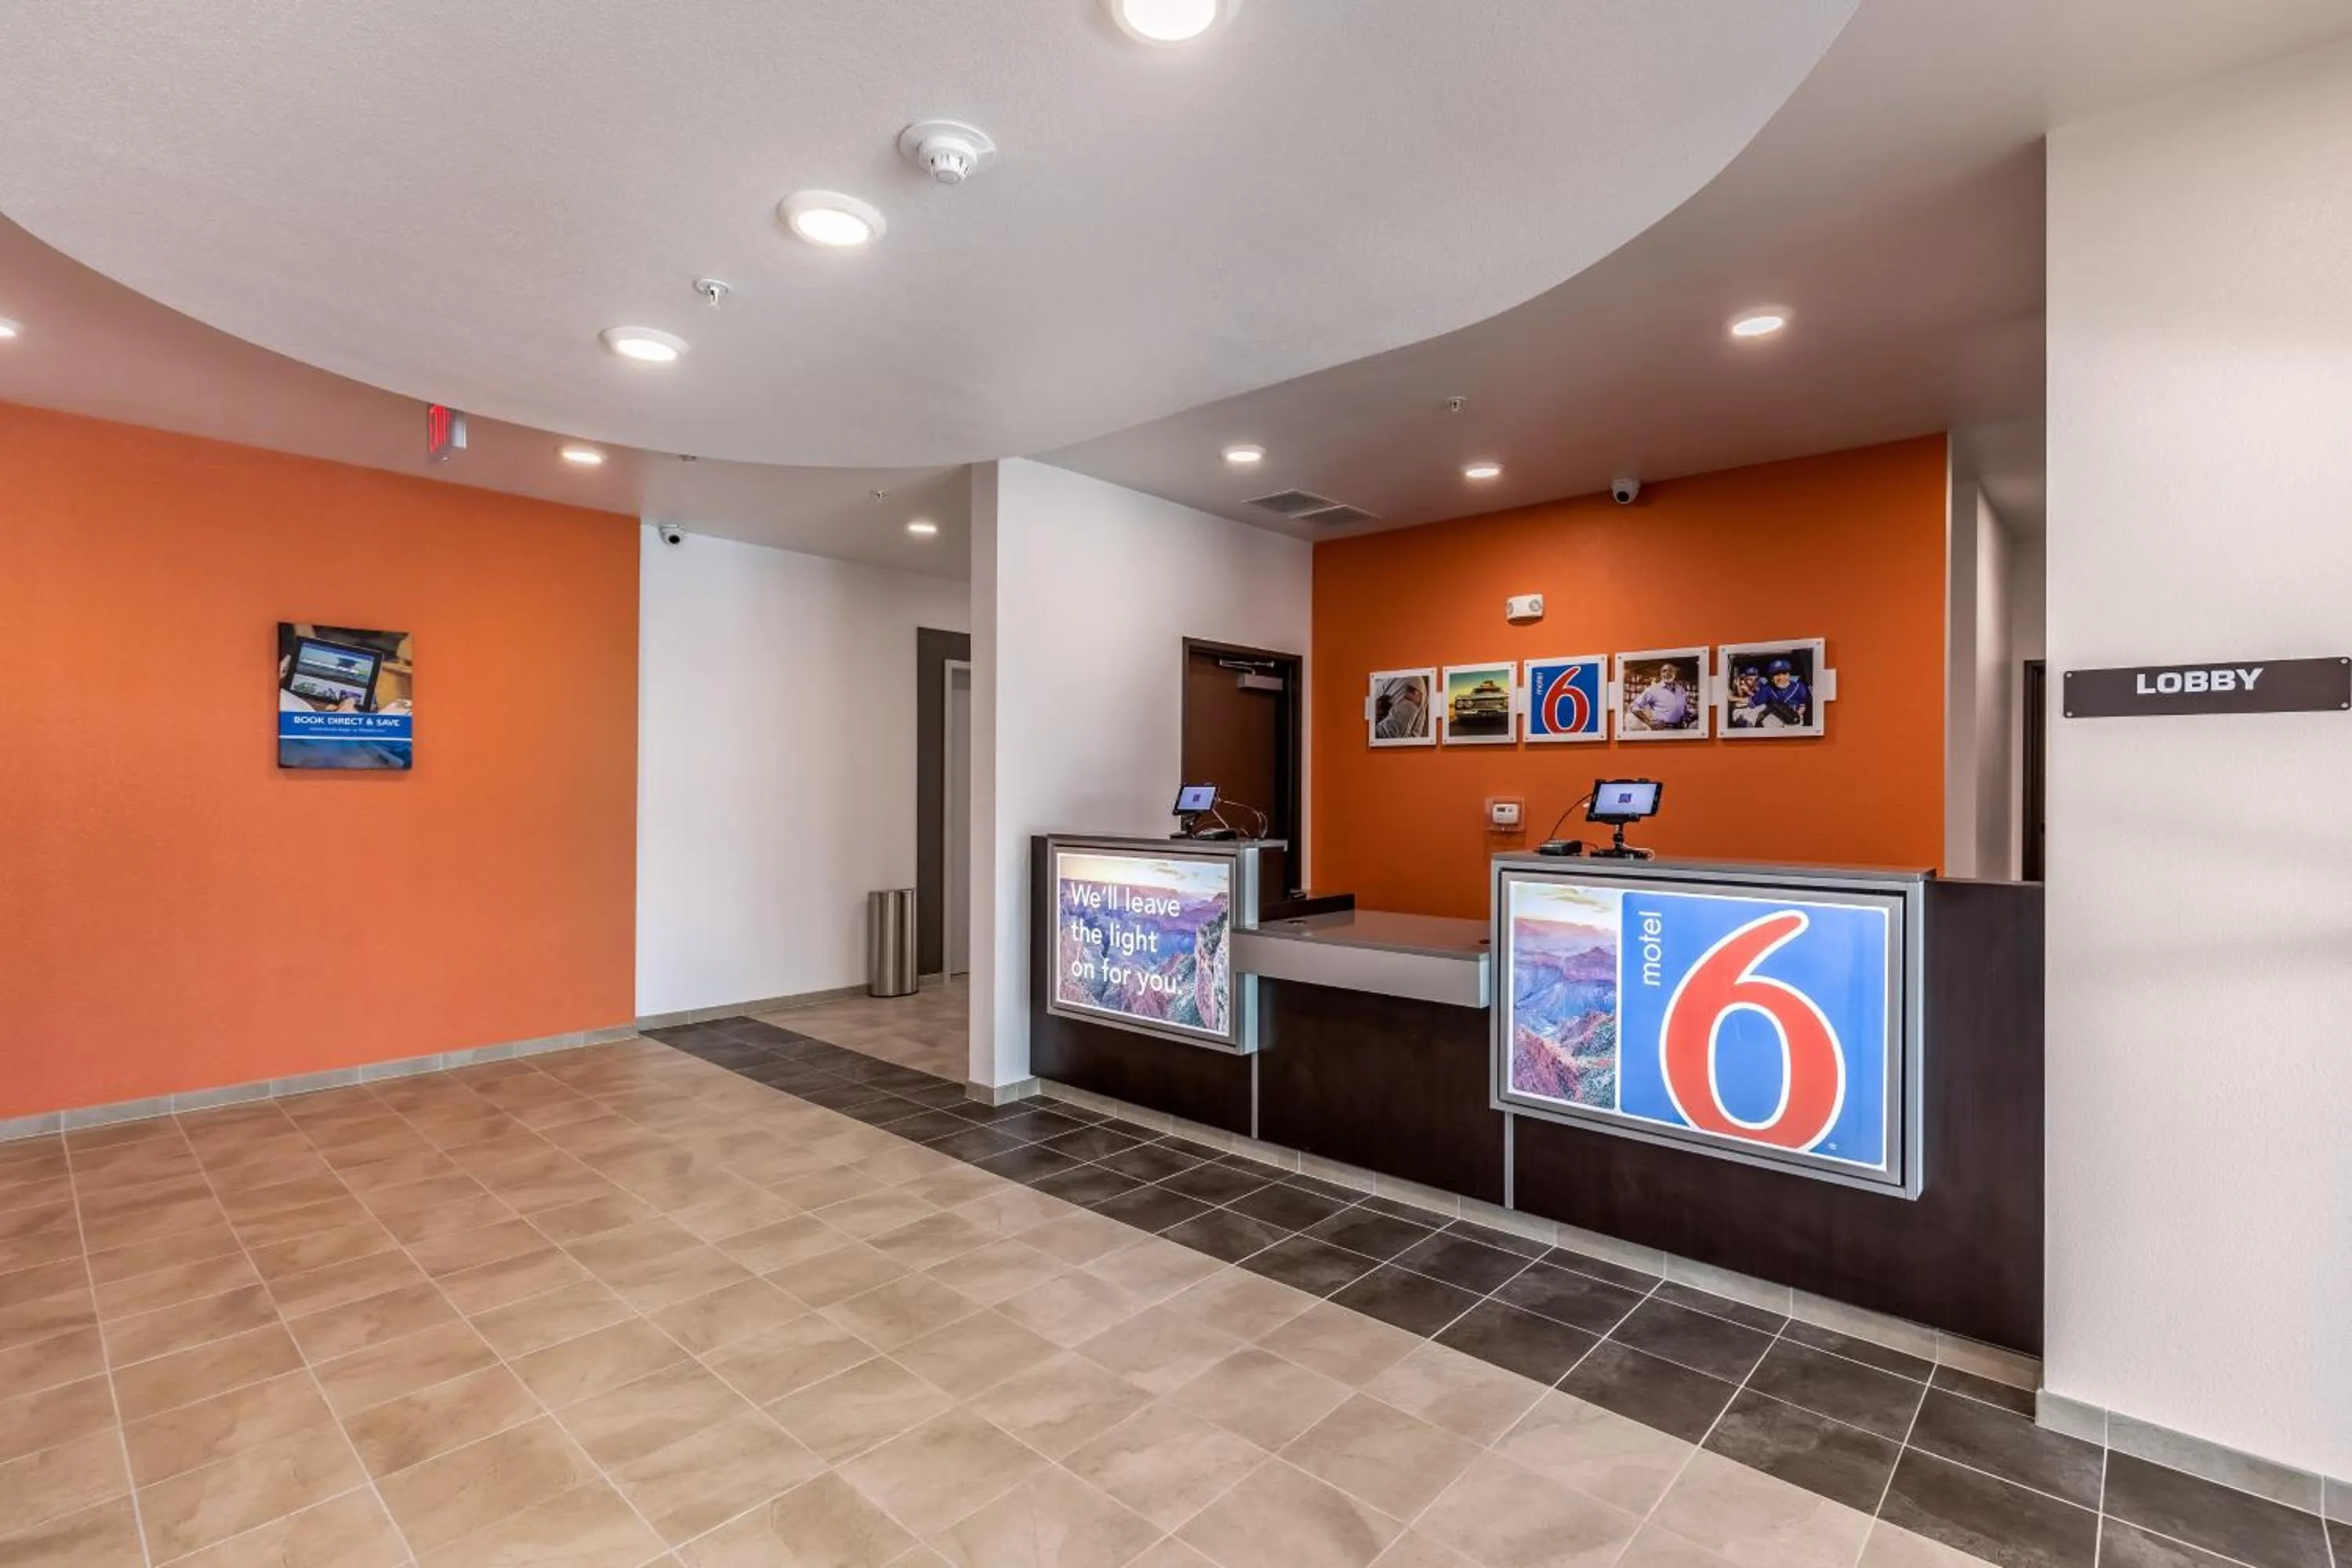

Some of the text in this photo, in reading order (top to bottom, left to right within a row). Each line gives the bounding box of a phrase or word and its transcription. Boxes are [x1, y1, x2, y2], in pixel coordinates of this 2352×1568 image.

[2136, 667, 2265, 694] LOBBY
[1541, 666, 1590, 734] 6
[293, 716, 324, 724] BOOK
[328, 717, 364, 725] DIRECT
[366, 717, 373, 726] &
[1070, 882, 1181, 917] We'll leave
[1071, 919, 1158, 956] the light
[1072, 960, 1094, 979] on
[1102, 958, 1131, 985] for
[1639, 909, 1846, 1151] motel 6
